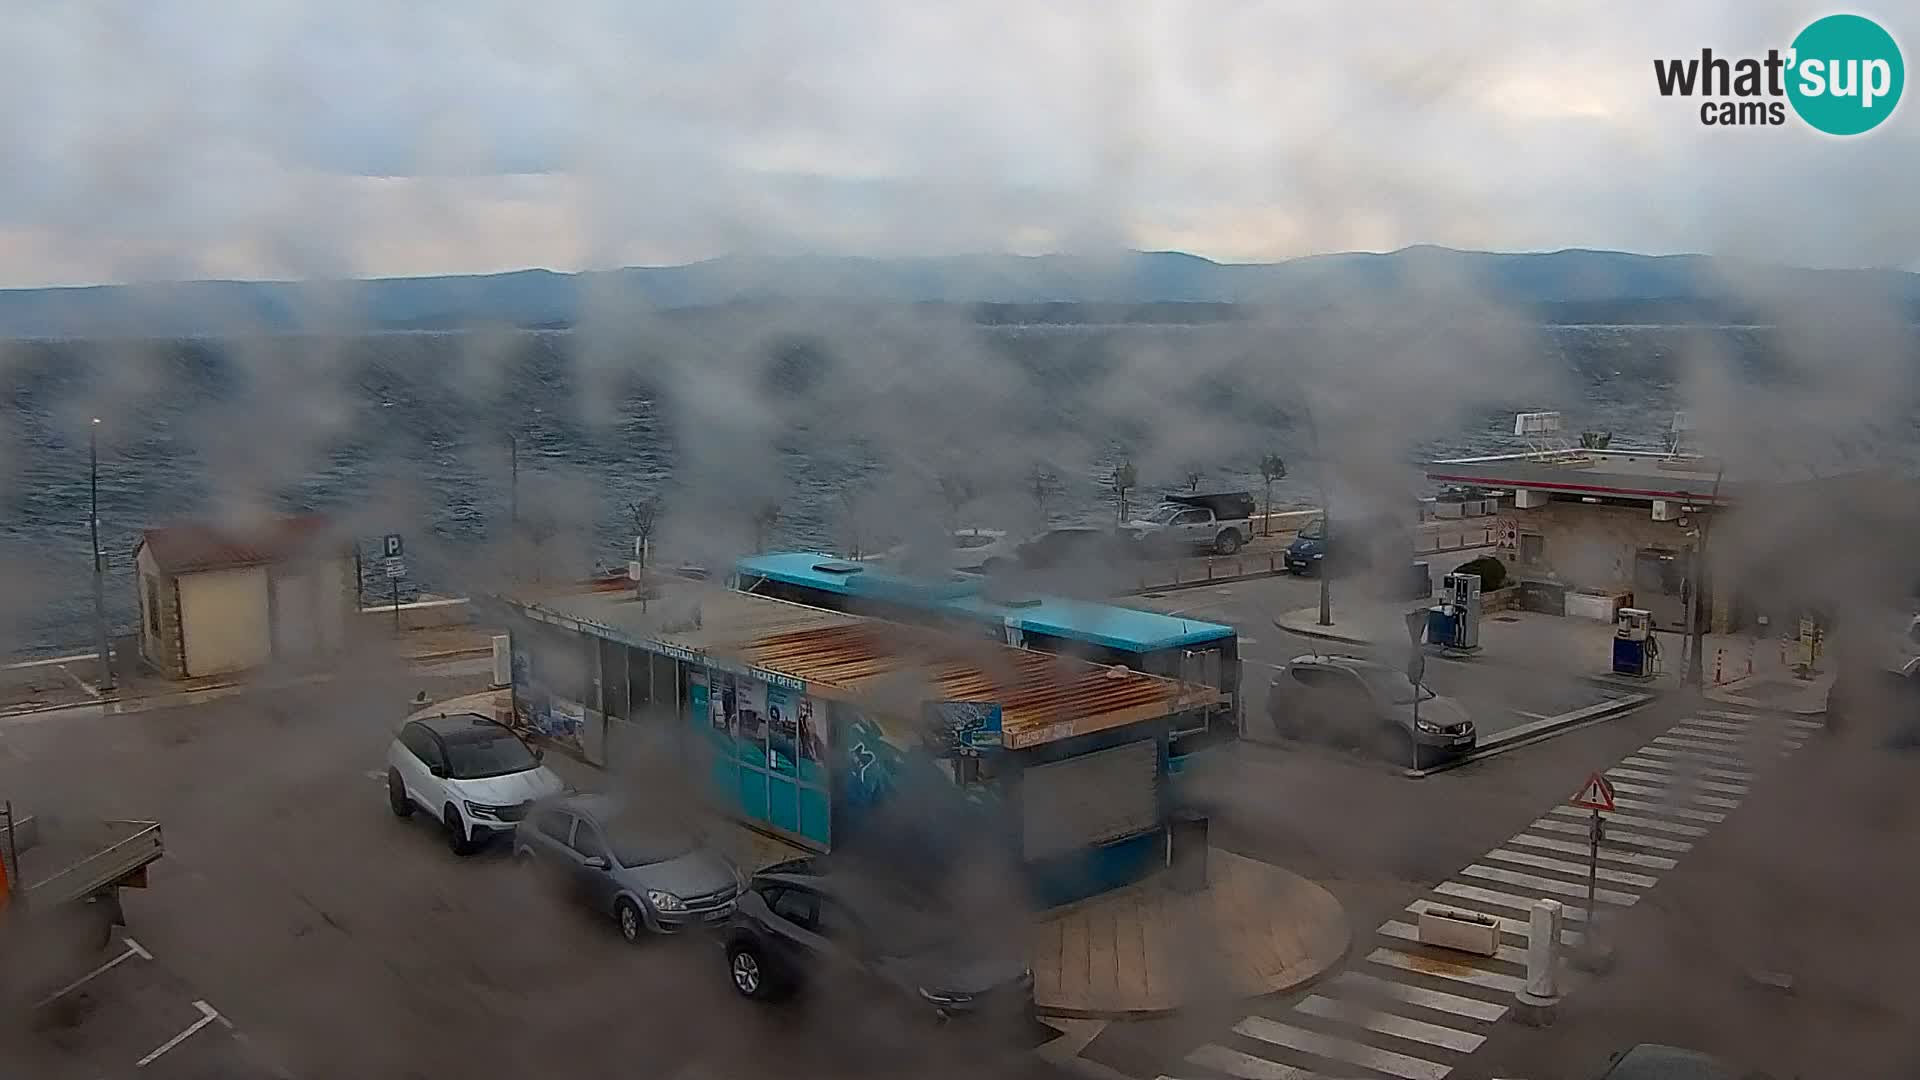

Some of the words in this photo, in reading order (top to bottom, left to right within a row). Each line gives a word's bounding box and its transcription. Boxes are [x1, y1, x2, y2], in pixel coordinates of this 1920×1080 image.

[388, 537, 399, 554] P
[752, 668, 776, 684] TICKET
[777, 675, 803, 690] OFFICE
